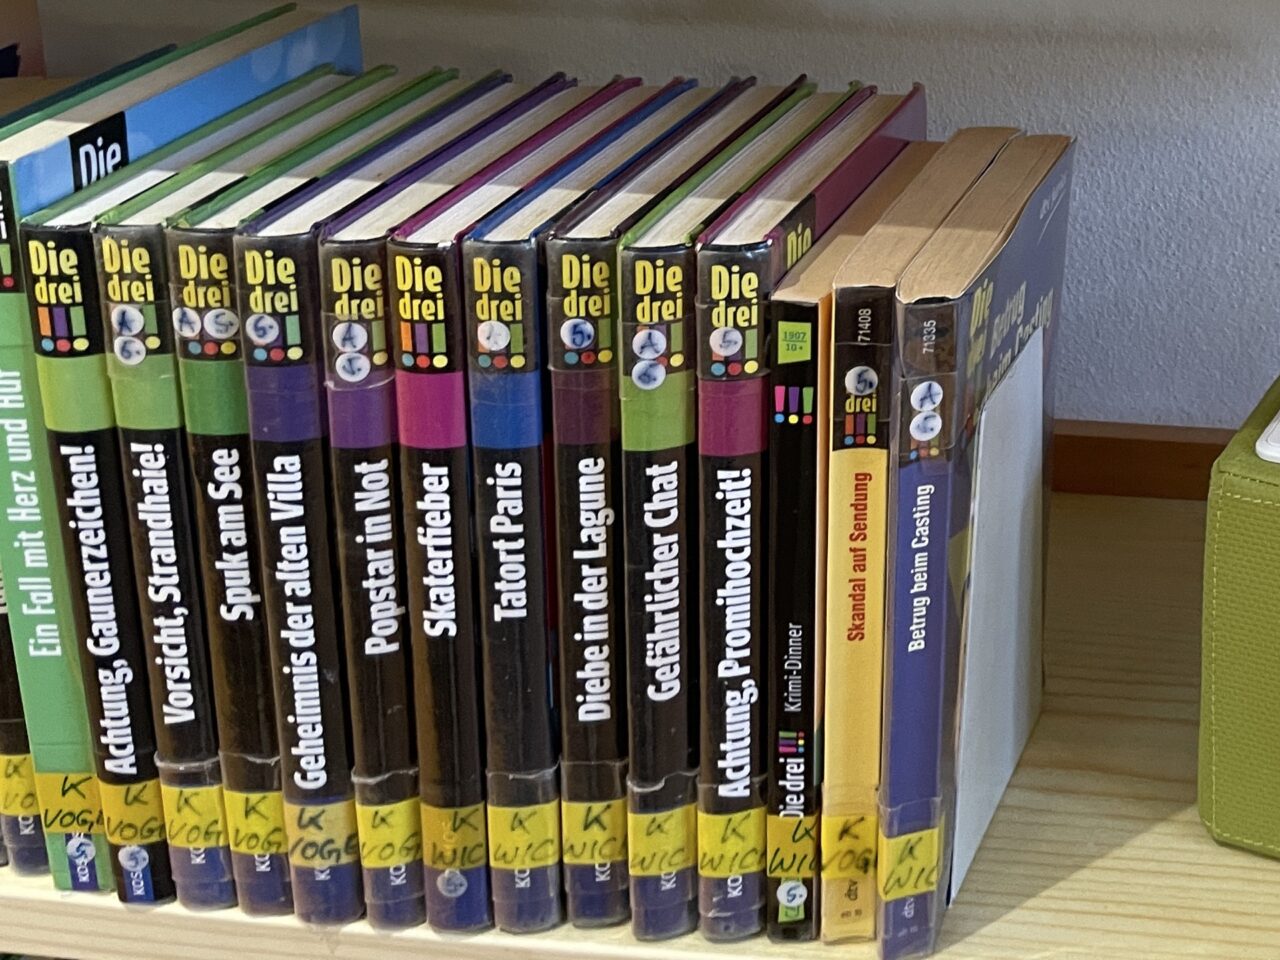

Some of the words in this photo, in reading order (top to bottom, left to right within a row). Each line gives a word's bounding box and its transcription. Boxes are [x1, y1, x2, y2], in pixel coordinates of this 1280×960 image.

[28, 240, 79, 277] Die
[101, 239, 151, 274] Die
[178, 244, 229, 280] Die
[245, 250, 296, 286] Die
[331, 257, 383, 293] Die
[395, 255, 443, 292] Die
[473, 256, 521, 293] Die
[561, 253, 611, 290] Die
[34, 275, 84, 306] drei
[106, 275, 156, 303] drei
[182, 280, 232, 309] drei
[634, 258, 683, 296] Die
[710, 265, 759, 300] Die
[249, 284, 299, 315] drei
[334, 291, 384, 321] drei
[398, 292, 445, 321] drei
[475, 291, 523, 321] drei
[563, 288, 611, 318] drei
[636, 292, 683, 324] drei
[711, 297, 759, 328] drei
[857, 307, 872, 344] 71408
[922, 319, 937, 355] 71335
[845, 393, 877, 413] drei
[6, 418, 32, 462] und
[207, 447, 243, 501] See
[266, 454, 305, 522] Villa
[354, 457, 391, 512] Not
[6, 470, 42, 522] Herz
[486, 461, 524, 533] Paris
[572, 456, 616, 560] Lagune
[643, 459, 679, 529] Chat
[848, 471, 873, 541] Sendung
[130, 442, 182, 603] Strandhaie!
[217, 504, 248, 547] am
[355, 514, 393, 545] in
[910, 483, 935, 549] Casting
[13, 530, 48, 568] mit
[59, 444, 122, 657] Gaunerzeichen!
[275, 525, 312, 598] alten
[416, 461, 457, 639] Skaterfieber
[849, 545, 868, 574] auf
[214, 548, 262, 622] Spuk
[492, 538, 528, 622] Tatort
[573, 562, 611, 603] der
[715, 467, 753, 679] Promihochzeit!
[910, 551, 931, 594] beim
[18, 576, 56, 616] Fall
[362, 548, 406, 656] Popstar
[847, 576, 867, 642] Skandal
[280, 602, 316, 649] der
[573, 605, 611, 642] in
[644, 531, 682, 702] Gefährlicher
[907, 593, 931, 653] Betrug
[29, 624, 62, 657] Ein
[152, 606, 196, 725] Vorsicht,
[575, 643, 612, 722] Diebe
[783, 622, 803, 713] Krimi-Dinner
[99, 658, 138, 776] Achtung,
[282, 651, 328, 791] Geheimnis
[717, 678, 759, 798] Achtung,
[61, 775, 93, 798] K
[778, 757, 805, 792] drei
[244, 795, 269, 821] K
[452, 808, 480, 832] K
[583, 803, 612, 832] K
[721, 813, 751, 844] K
